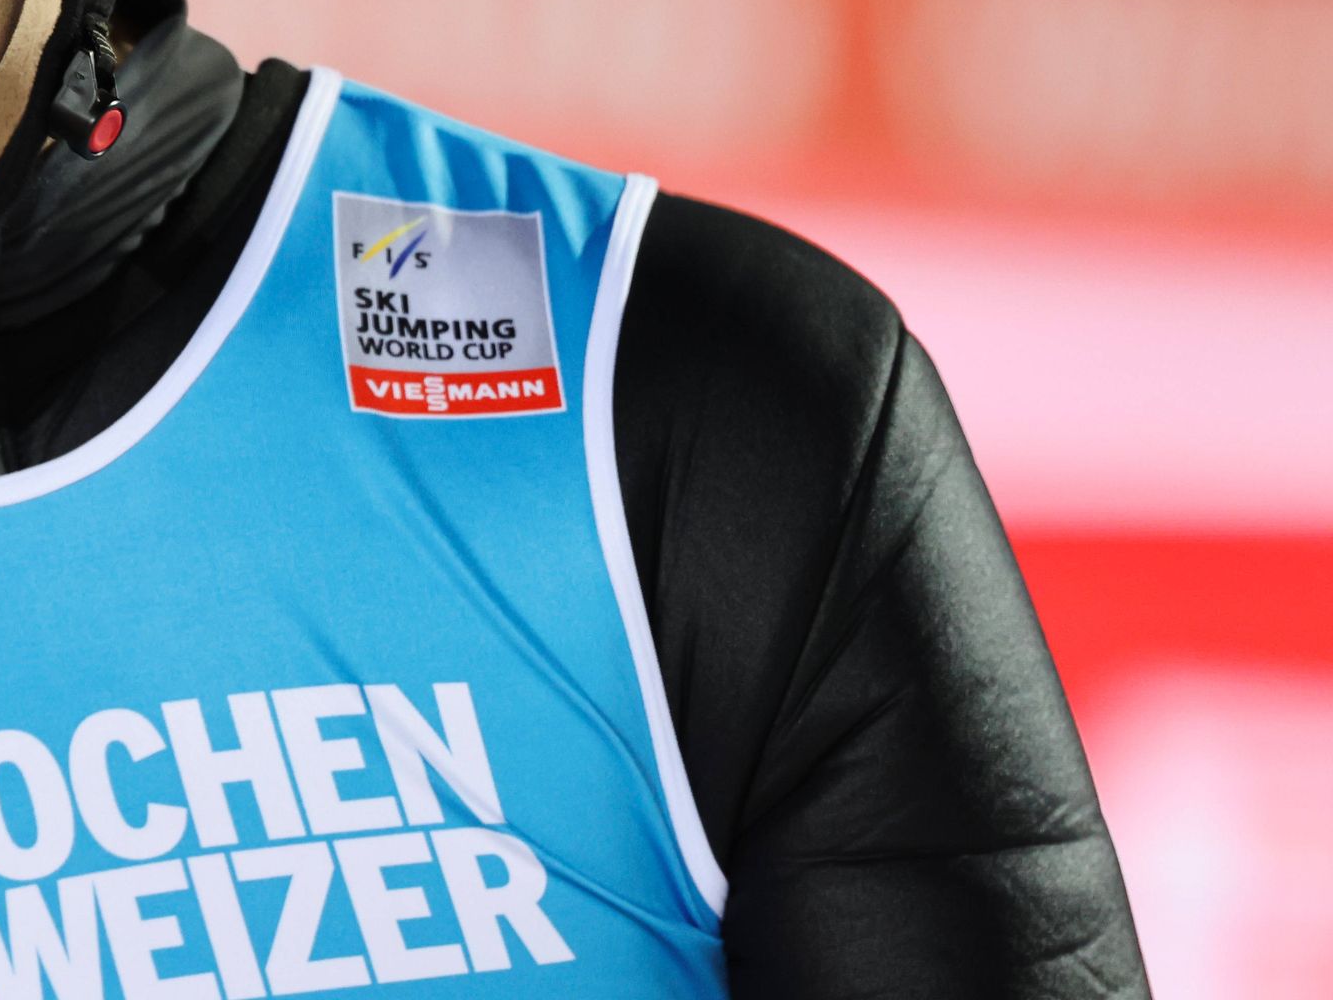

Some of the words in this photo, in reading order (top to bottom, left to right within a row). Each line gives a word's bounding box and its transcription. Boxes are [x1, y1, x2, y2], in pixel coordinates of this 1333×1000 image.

[352, 242, 431, 269] FIS
[354, 287, 410, 315] SKI
[357, 312, 516, 341] JUMPING
[358, 336, 454, 361] WORLD
[463, 342, 513, 361] CUP
[366, 376, 545, 412] VIESSMANN
